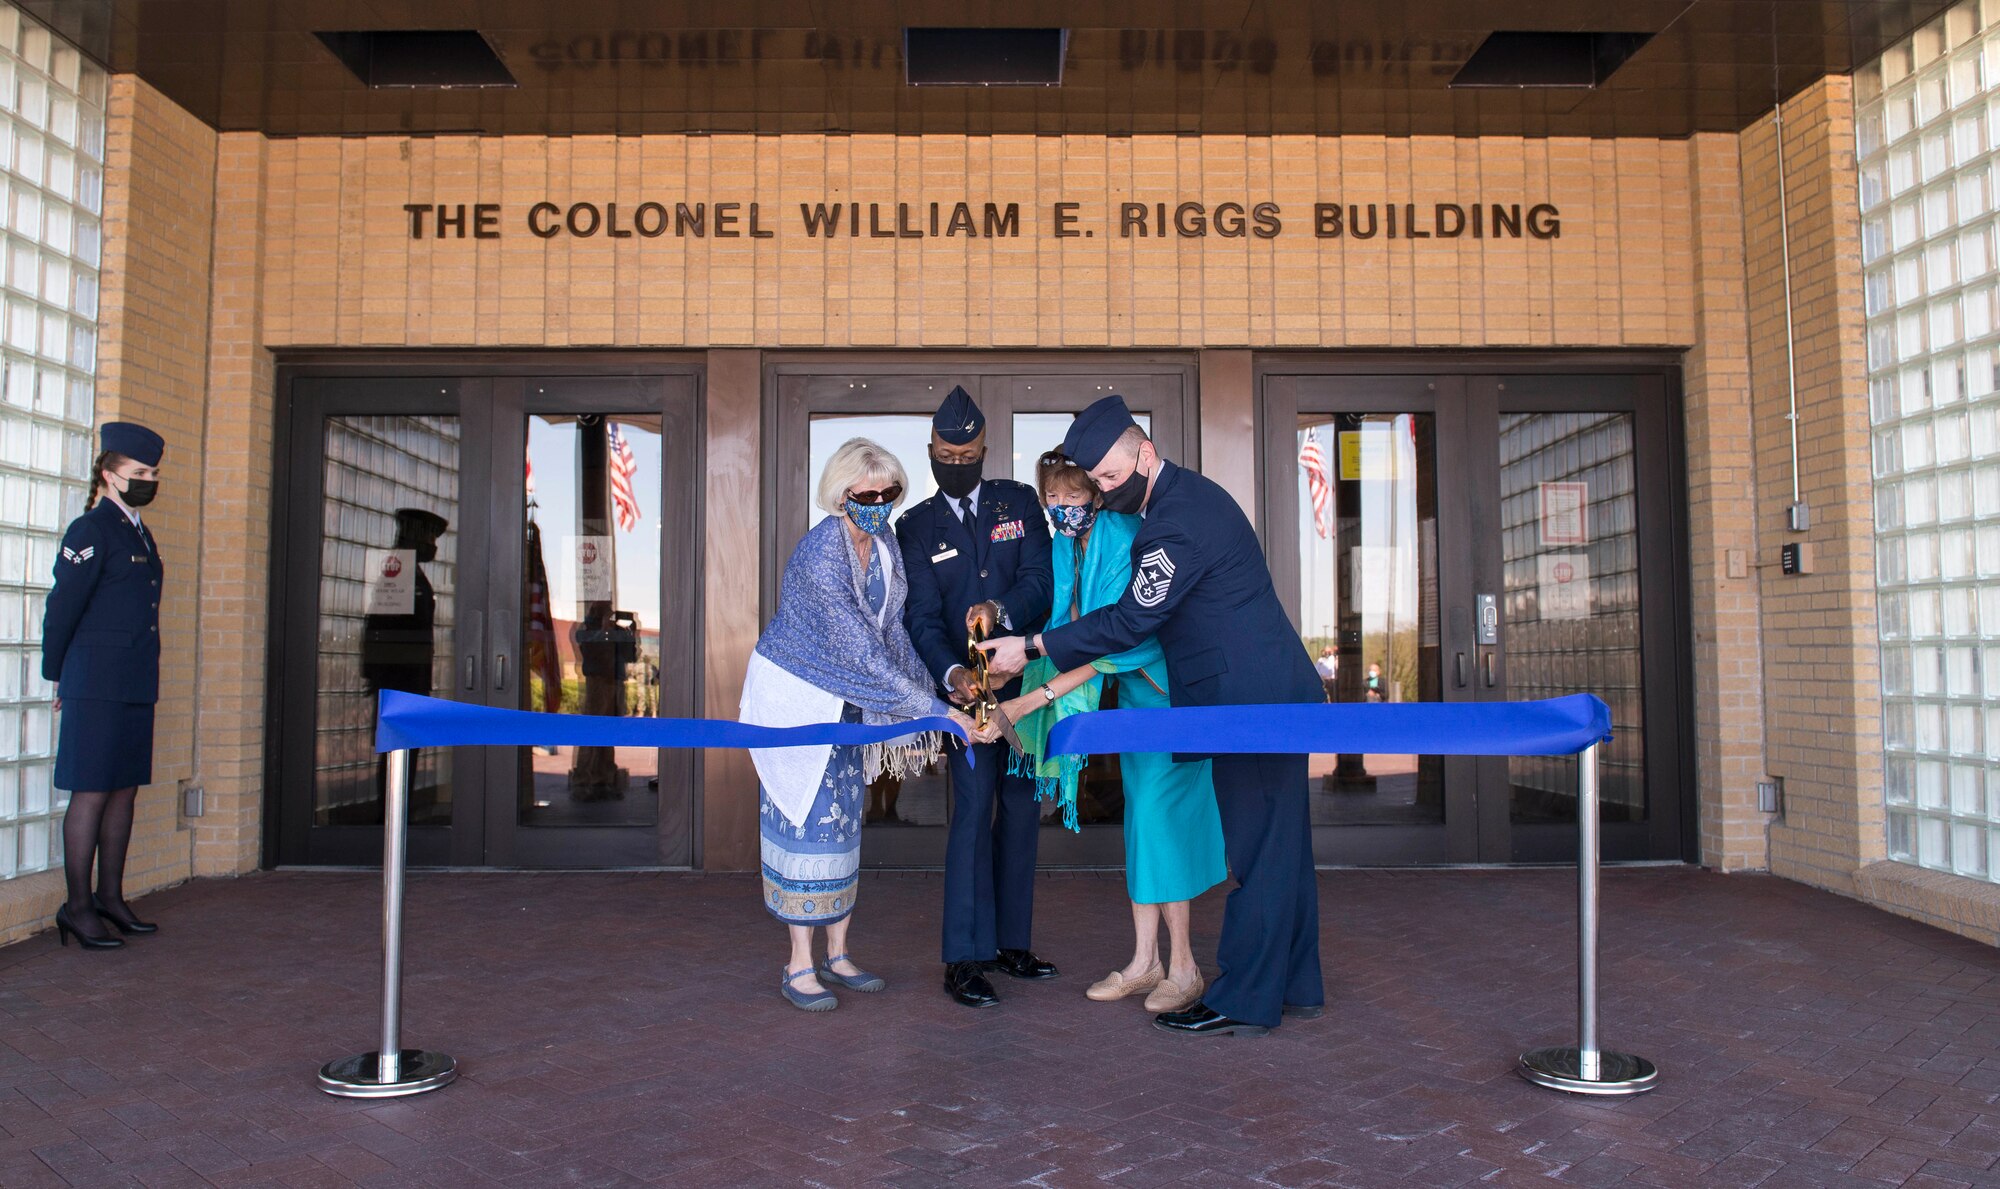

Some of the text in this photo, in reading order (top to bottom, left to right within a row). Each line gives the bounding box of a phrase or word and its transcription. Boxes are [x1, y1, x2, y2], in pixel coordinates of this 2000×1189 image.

[403, 201, 1561, 240] THE COLONEL WILLIAM E. RIGGS BUILDING
[382, 563, 400, 571] STOP
